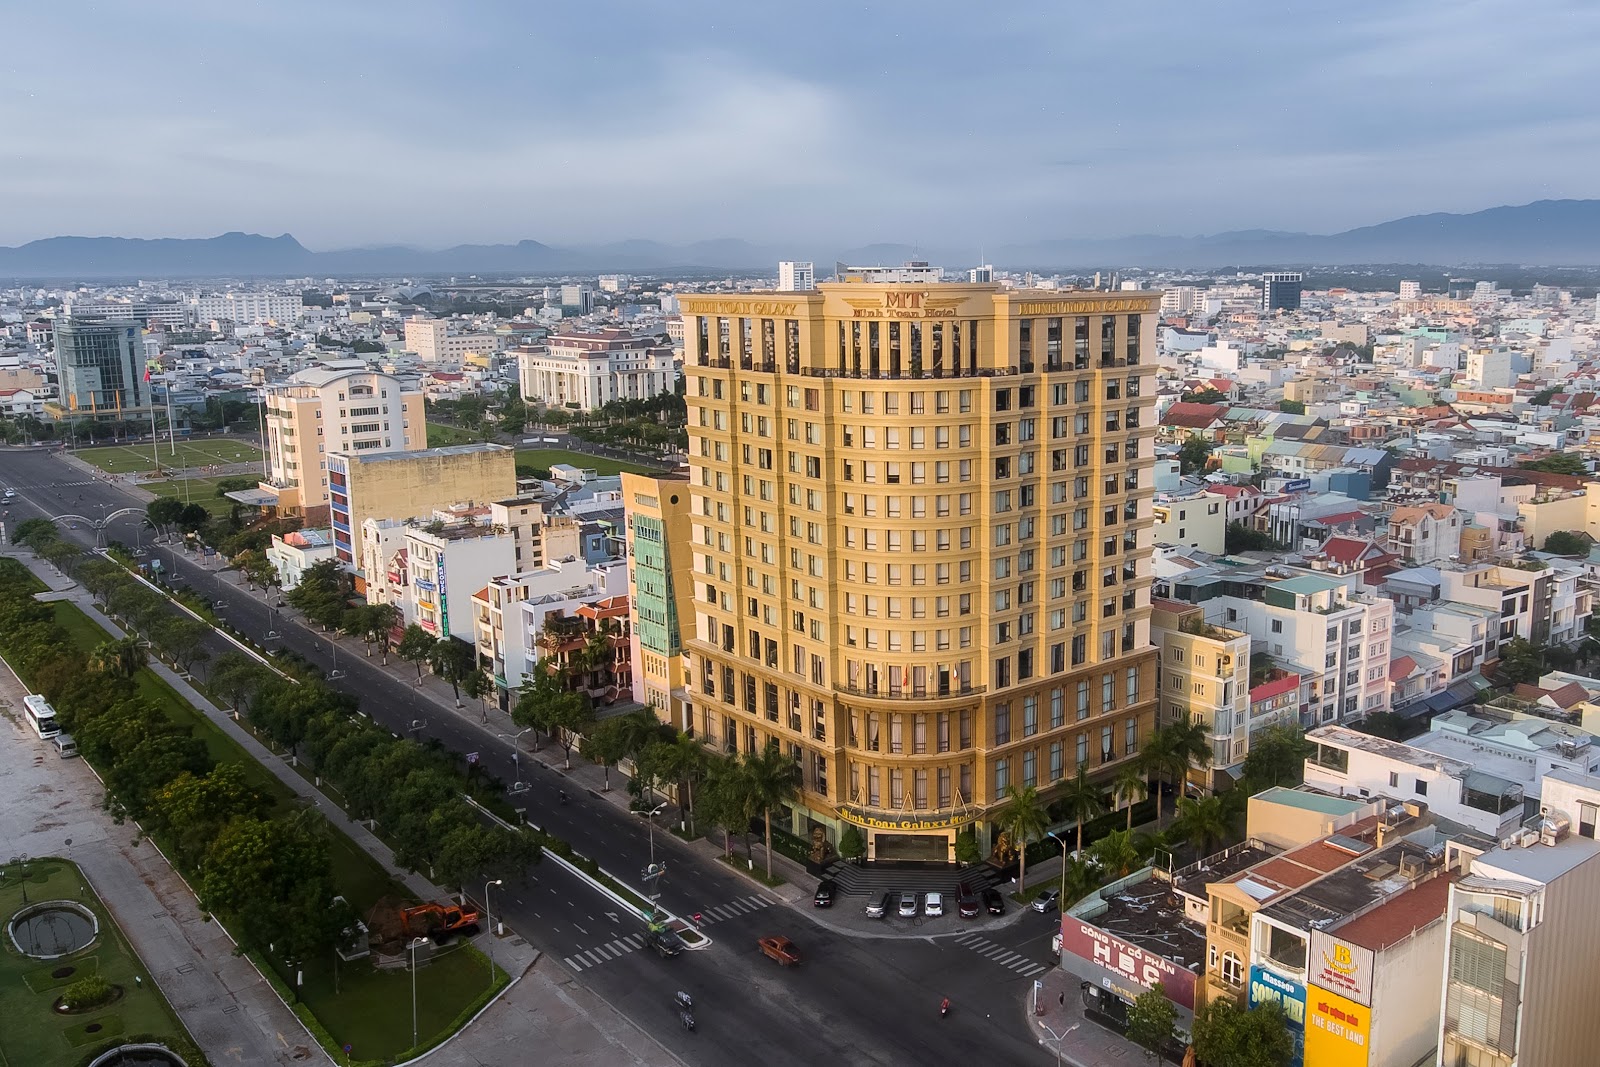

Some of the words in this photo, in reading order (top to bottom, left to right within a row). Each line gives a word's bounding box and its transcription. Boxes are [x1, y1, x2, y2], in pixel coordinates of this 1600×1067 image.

[753, 302, 797, 316] GALAXY
[885, 291, 924, 309] MT
[1103, 299, 1151, 312] GALAXY
[853, 309, 883, 318] Minh
[887, 309, 919, 318] Toan
[924, 308, 957, 318] Hotel
[841, 808, 865, 823] Minh
[868, 817, 897, 828] Toan
[1081, 925, 1109, 944] CÔNG
[1112, 939, 1126, 952] TY
[1262, 971, 1295, 993] Massage
[1311, 1013, 1324, 1029] THE
[1326, 1020, 1344, 1037] BEST
[1345, 1028, 1364, 1046] LAND
